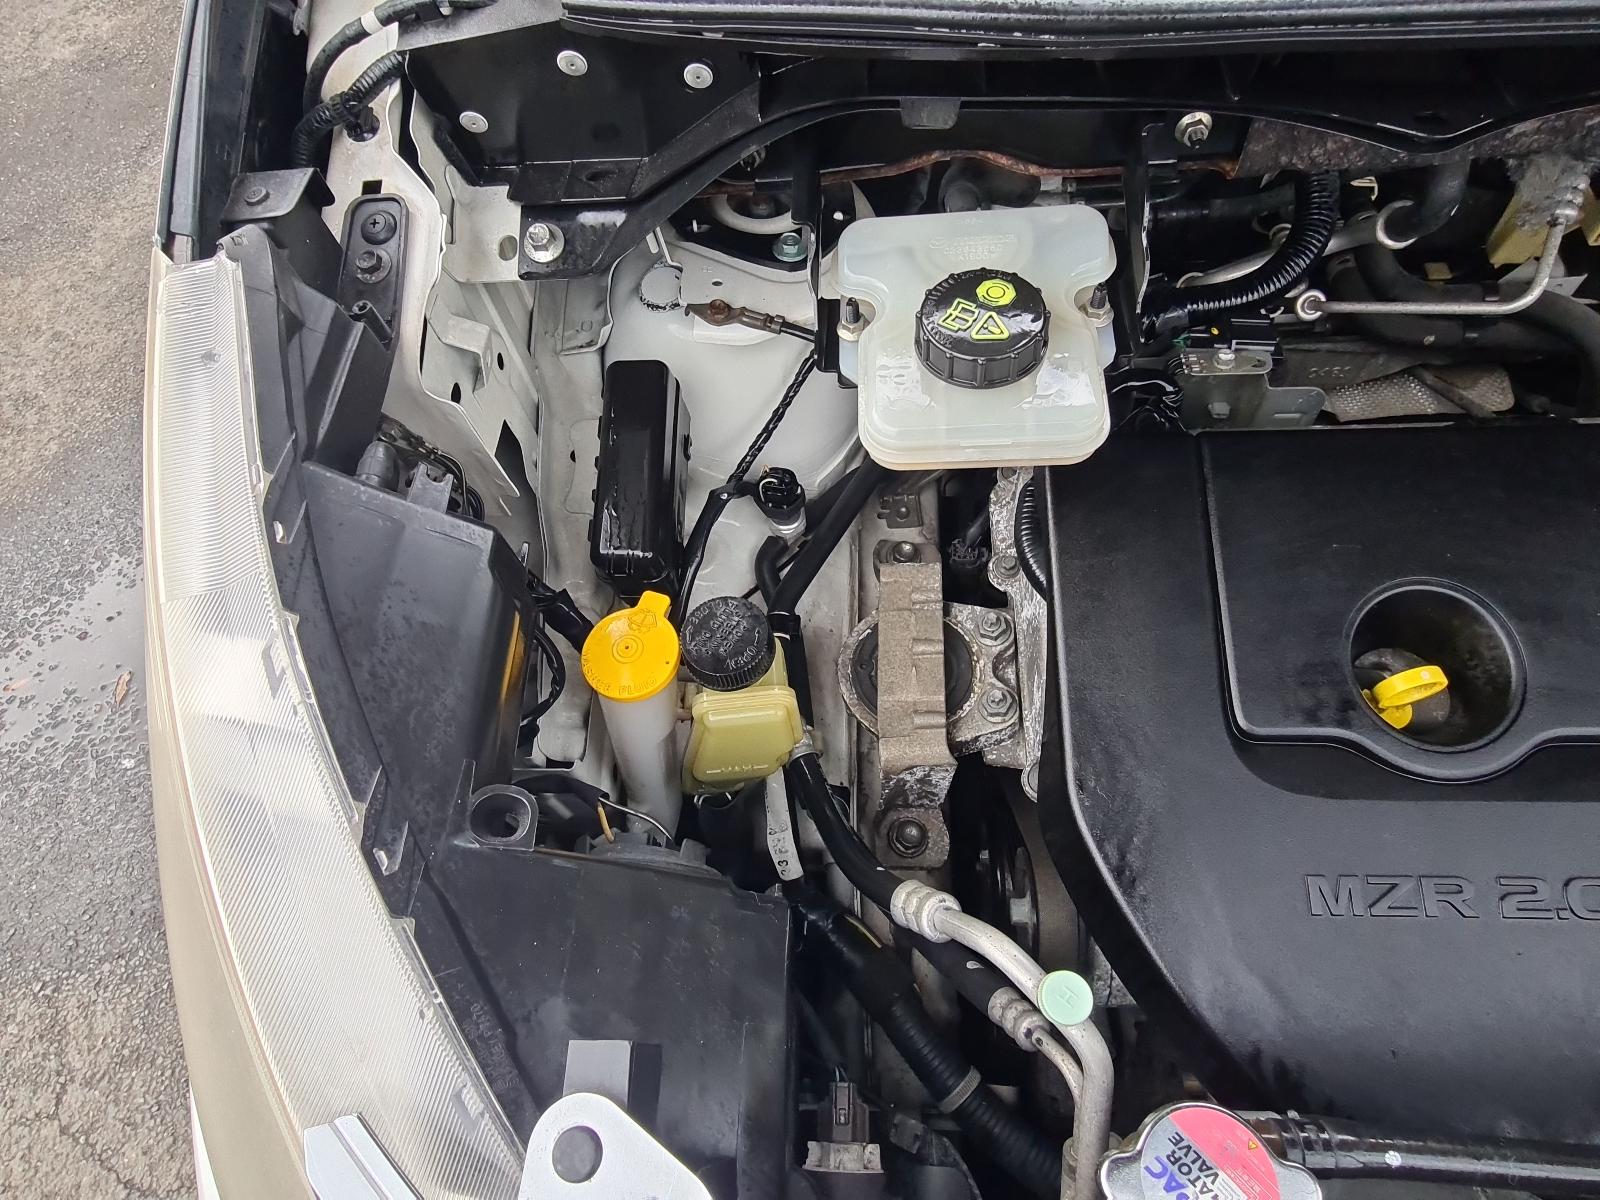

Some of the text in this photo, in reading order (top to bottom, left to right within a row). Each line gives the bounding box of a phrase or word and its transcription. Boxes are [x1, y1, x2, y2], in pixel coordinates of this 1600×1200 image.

[710, 599, 739, 631] FLUID
[703, 610, 743, 657] STEERING
[718, 621, 749, 657] POWER
[729, 645, 758, 671] OPEN
[618, 678, 657, 696] FLUID
[1304, 873, 1480, 919] MZR
[1167, 1131, 1220, 1186] VALVE
